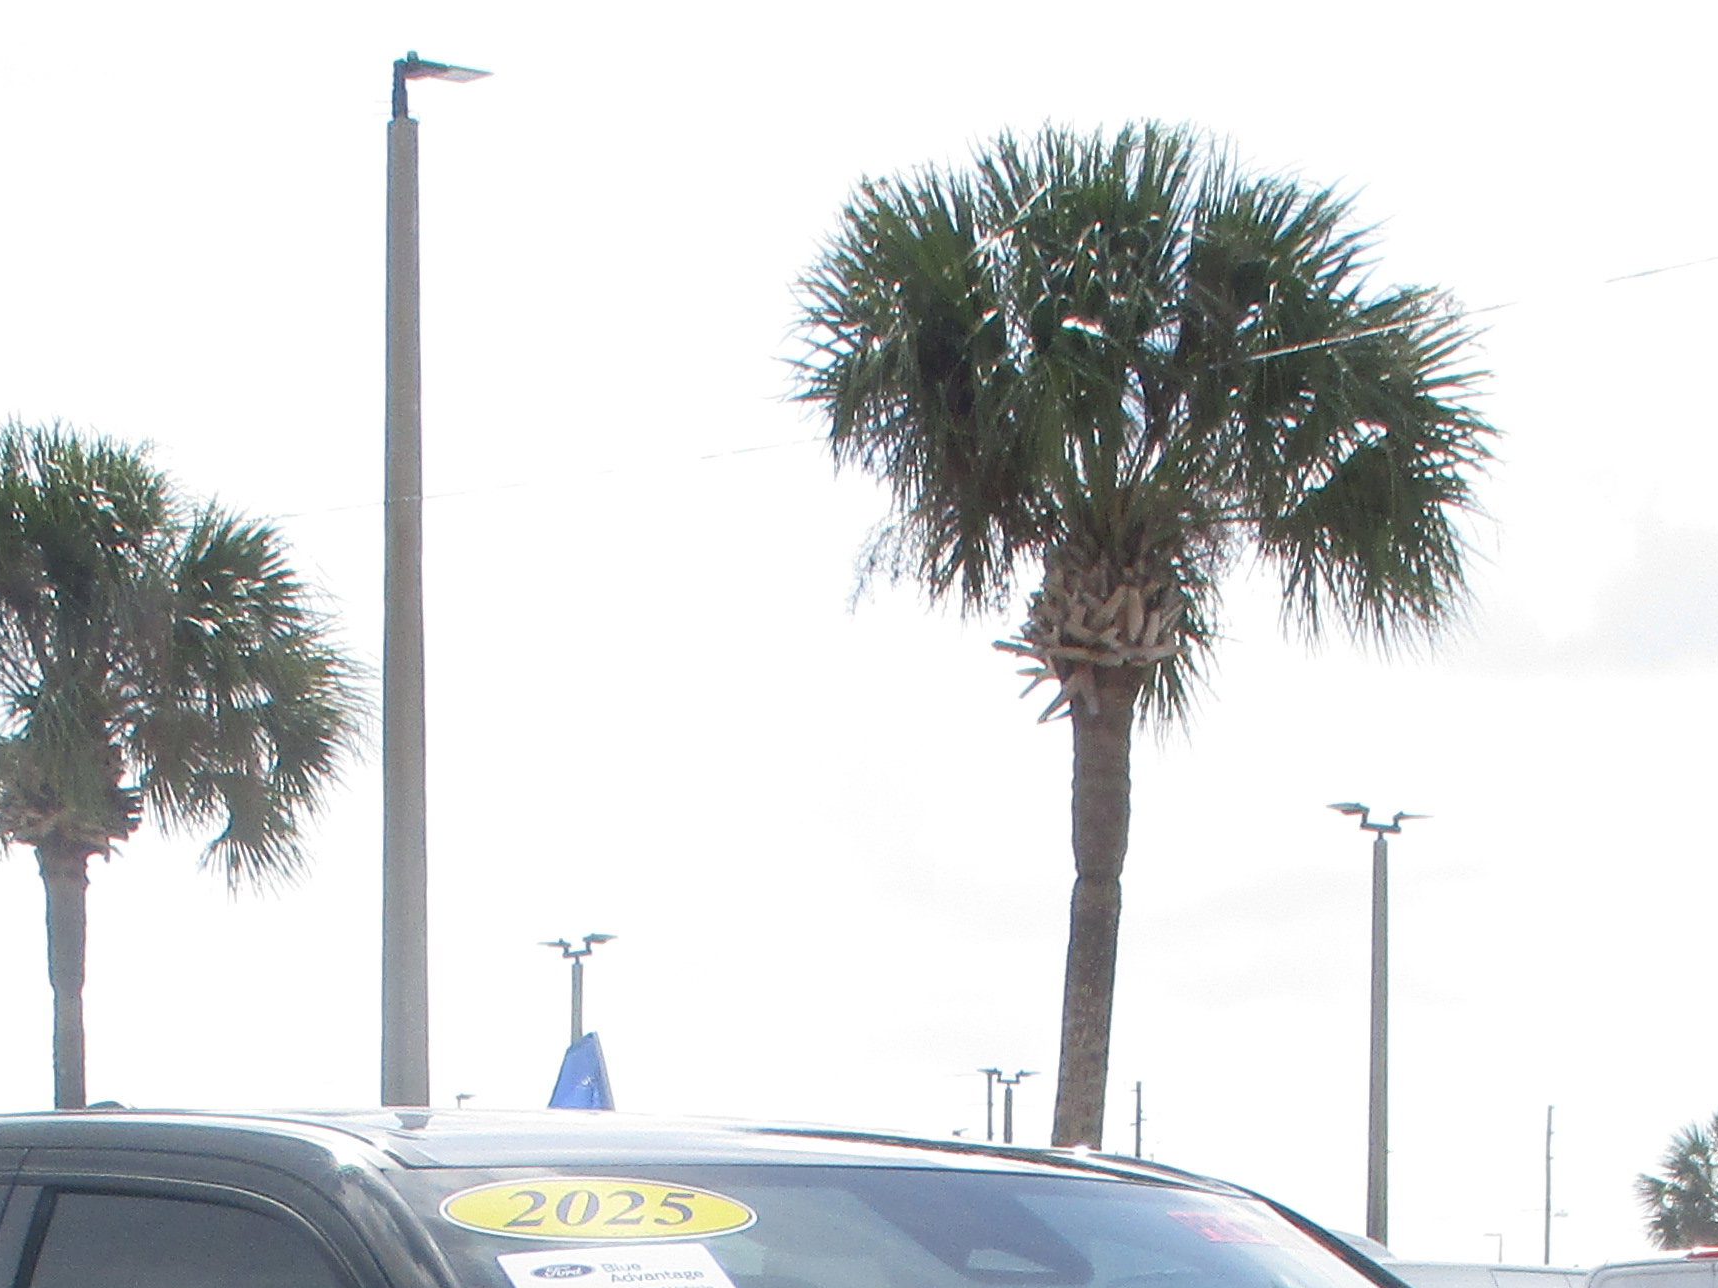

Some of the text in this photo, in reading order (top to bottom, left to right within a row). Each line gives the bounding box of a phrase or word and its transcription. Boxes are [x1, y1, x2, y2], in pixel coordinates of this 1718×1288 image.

[503, 1190, 695, 1228] 2025
[600, 1263, 642, 1273] Blue
[610, 1269, 705, 1283] Advantage
